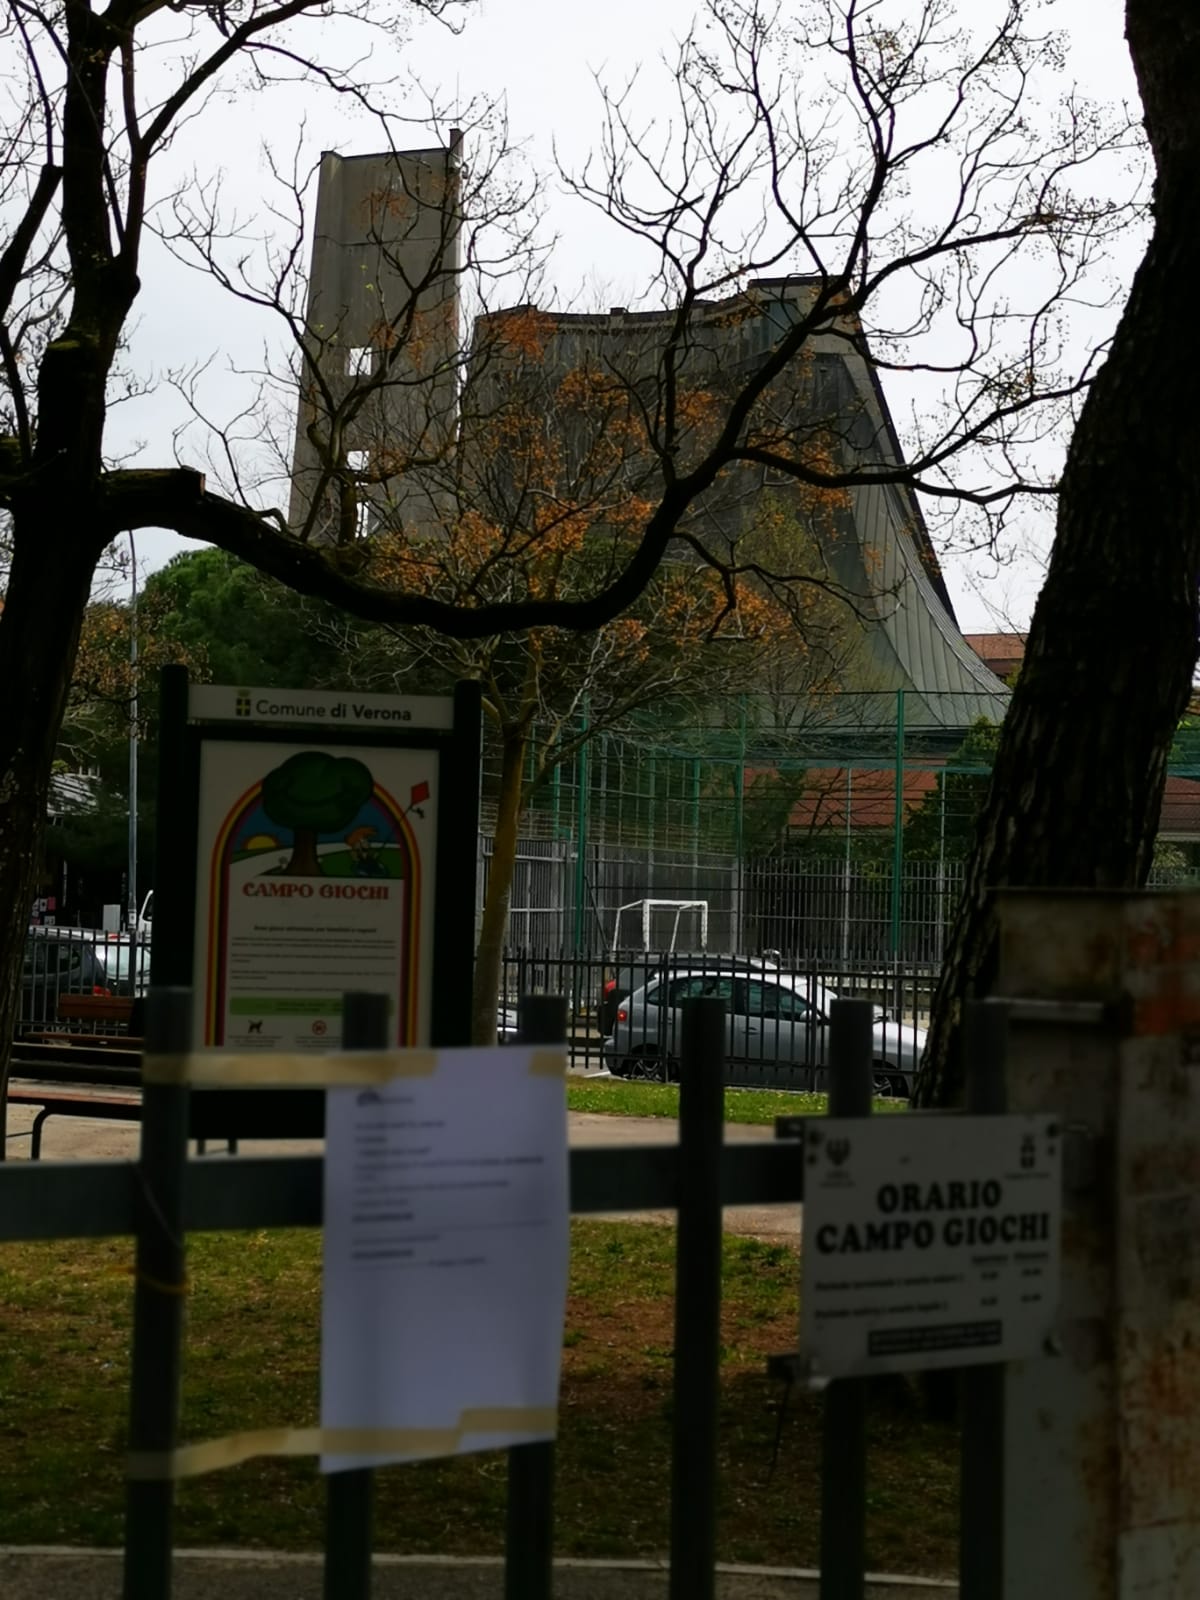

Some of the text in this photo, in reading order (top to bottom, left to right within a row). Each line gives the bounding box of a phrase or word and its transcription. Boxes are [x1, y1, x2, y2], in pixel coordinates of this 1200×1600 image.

[256, 699, 412, 721] Comune di Verona
[242, 882, 389, 900] CAMPO GIOCHI
[877, 1180, 1003, 1213] ORARIO
[816, 1212, 1051, 1254] CAMPO GIOCHI
